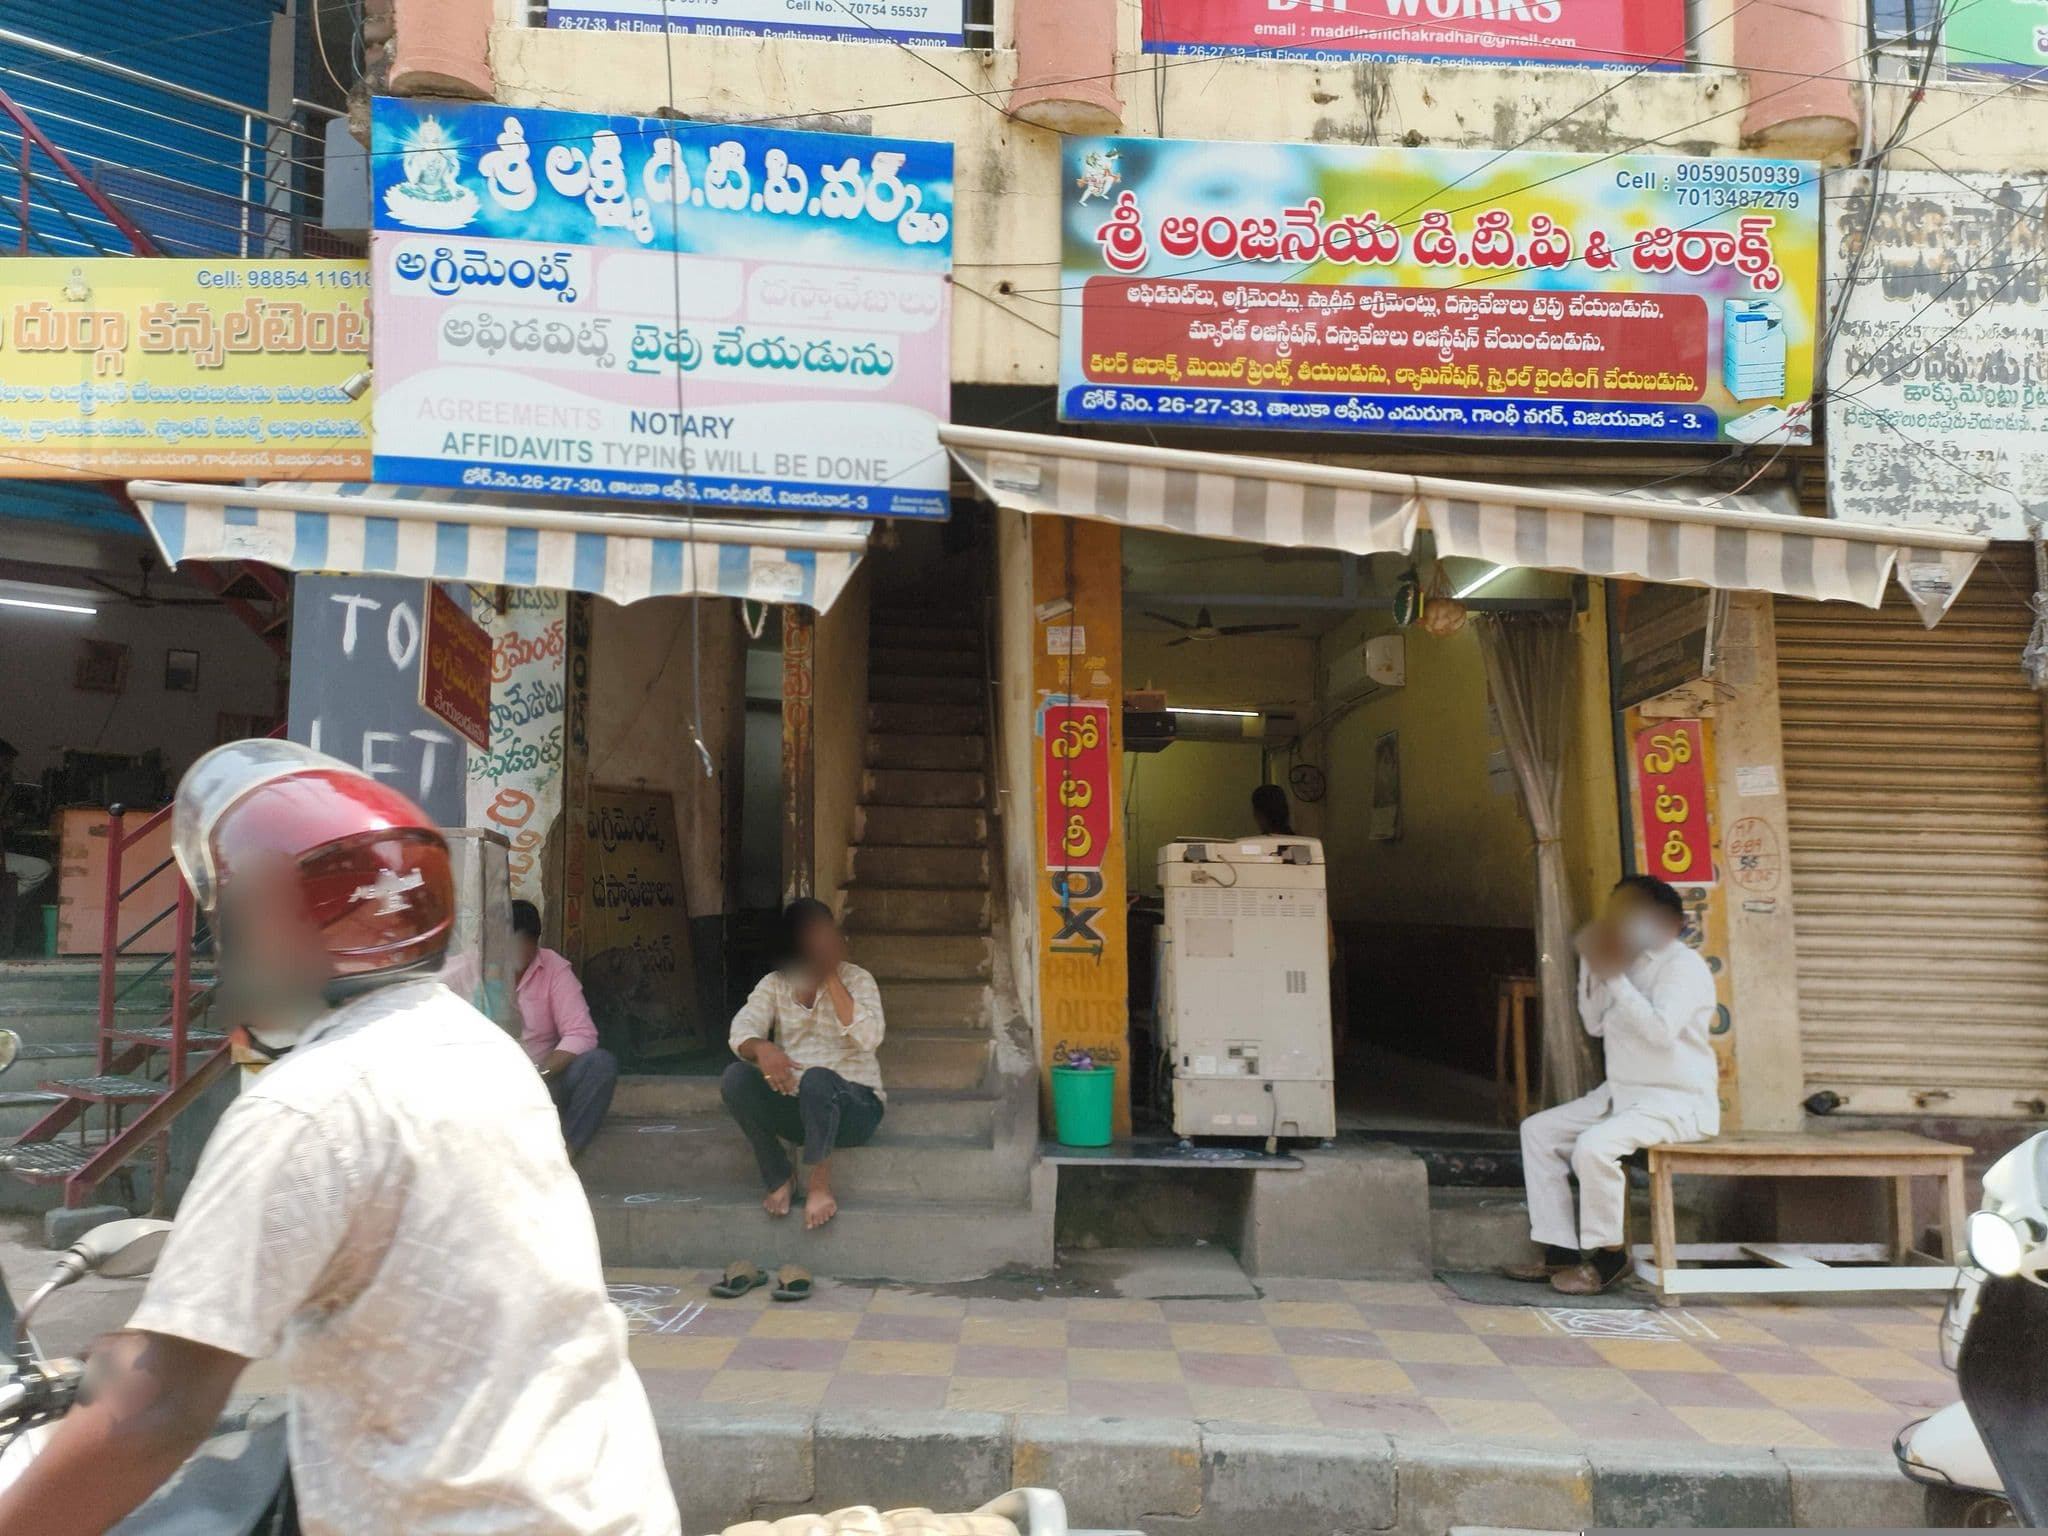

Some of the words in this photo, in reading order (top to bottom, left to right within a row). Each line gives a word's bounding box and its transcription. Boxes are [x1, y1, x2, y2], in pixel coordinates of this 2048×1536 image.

[787, 0, 810, 11] Cell
[815, 1, 836, 12] No.
[850, 4, 886, 16] 70754
[890, 6, 928, 18] 55537
[1254, 24, 1296, 36] email
[478, 115, 538, 212] శ్రీ
[1616, 171, 1656, 189] Cell
[1676, 163, 1801, 185] 9059050939
[1676, 187, 1800, 209] 7013487279
[1096, 191, 1148, 272] శ్రీ
[1159, 199, 1401, 264] ఆంజనేయ
[1583, 230, 1617, 270] &
[1632, 217, 1781, 290] జిరాక్స్
[197, 270, 243, 288] Cell:
[247, 270, 309, 288] 98854
[396, 247, 578, 304] అగ్రిమెంట్స్
[1445, 292, 1528, 321] దస్తావేజులు
[1528, 297, 1564, 322] టైపు
[1568, 294, 1664, 319] చేయబడును.
[13, 302, 129, 376] దుర్గా
[443, 312, 617, 369] అఫిడవిట్స్
[626, 324, 703, 375] టైపు
[712, 325, 895, 377] చేయడును
[1325, 323, 1409, 352] దస్తావేజులు
[1484, 326, 1605, 352] చేయించబడును.
[1090, 352, 1128, 374] కలర్
[1186, 355, 1248, 379] మెయిల్
[1534, 367, 1599, 394] బైండింగ్
[1603, 367, 1699, 392] చేయబడును.
[416, 396, 602, 432] AGREEMENTS
[630, 410, 736, 440] NOTARY
[1081, 389, 1118, 410] డోర్
[1120, 393, 1153, 411] నెం.
[1266, 399, 1331, 419] తాలుకా
[1333, 398, 1384, 422] ఆఫీసు
[1387, 403, 1468, 423] ఎదురుగా,
[1471, 404, 1521, 426] గాంధీ
[1523, 405, 1569, 426] నగర్,
[1572, 409, 1665, 429] విజయవాడ
[1683, 413, 1702, 429] 3.
[441, 431, 593, 464] AFFIDAVITS
[601, 441, 697, 472] TYPING
[704, 448, 767, 475] WILL
[775, 452, 808, 478] BE
[816, 456, 889, 483] DONE
[329, 593, 420, 671] TO
[1044, 957, 1119, 993] PRINT
[1055, 998, 1121, 1034] OUTS
